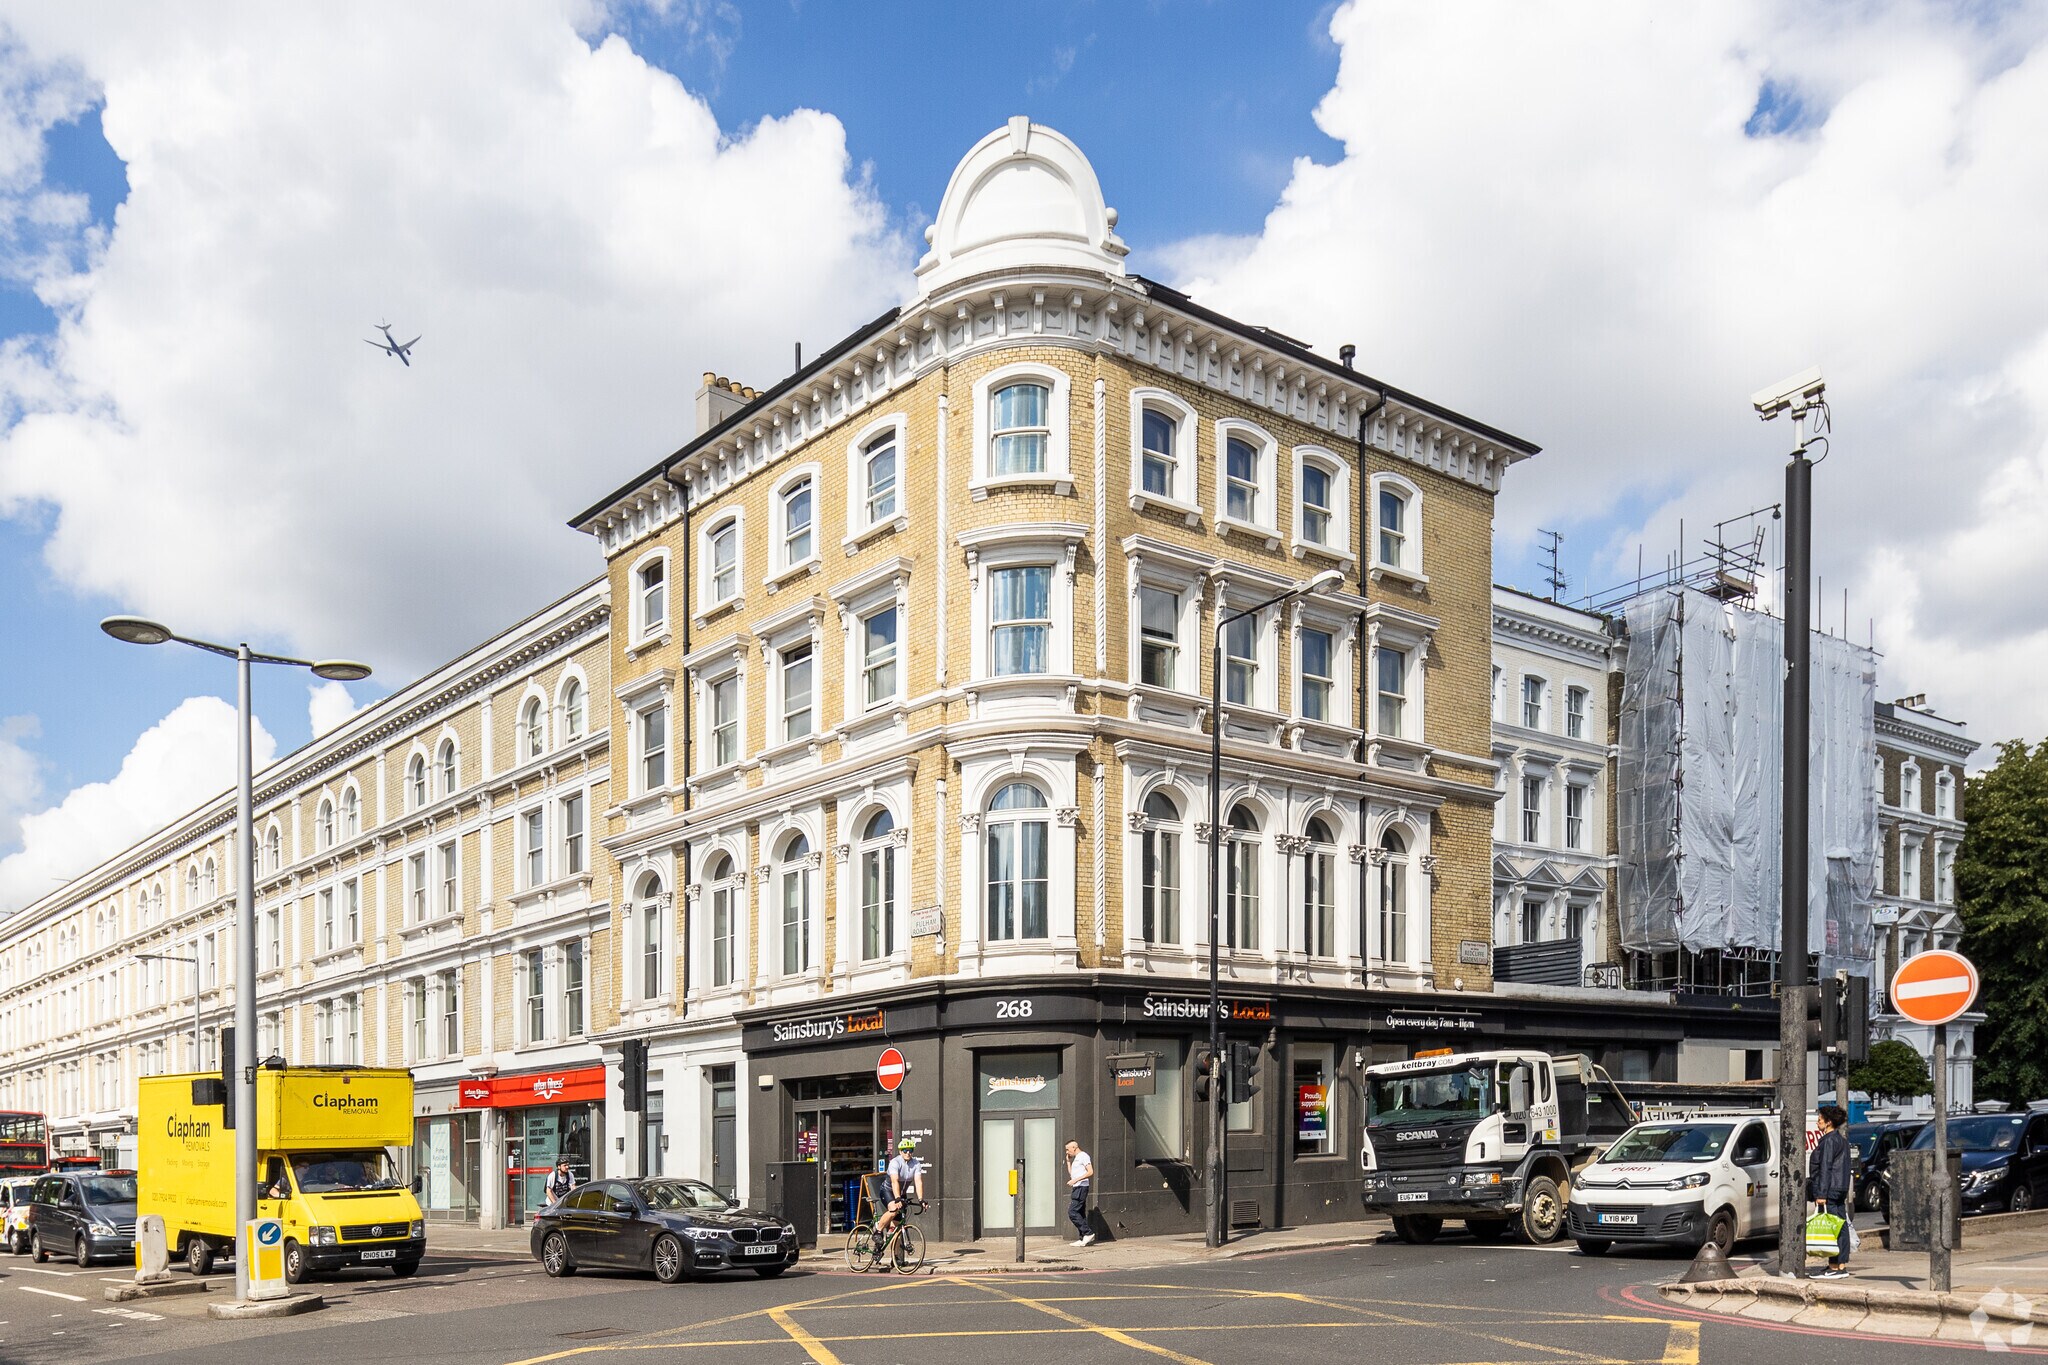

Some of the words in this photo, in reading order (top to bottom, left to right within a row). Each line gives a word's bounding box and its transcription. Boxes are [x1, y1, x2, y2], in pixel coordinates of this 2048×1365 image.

[916, 919, 937, 929] FULHAM
[913, 927, 927, 935] ROAD
[996, 1000, 1032, 1018] 268
[1143, 997, 1229, 1019] Sainsbur's
[1233, 1001, 1271, 1020] Local
[773, 1016, 845, 1041] Sainsbury's
[847, 1010, 884, 1032] Local
[1386, 1015, 1405, 1028] Open
[1406, 1018, 1425, 1029] every
[1426, 1017, 1438, 1029] day
[1439, 1017, 1454, 1028] 7am
[1459, 1018, 1475, 1030] 11pm
[1117, 1068, 1152, 1078] Sainsbury's
[534, 1079, 547, 1091] urban
[988, 1074, 1045, 1087] Sainsbury's
[1117, 1077, 1135, 1087] Local
[313, 1091, 378, 1110] Clapham
[1304, 1093, 1322, 1101] Proudly
[1543, 1105, 1556, 1116] 1000
[167, 1111, 211, 1143] Clapham
[924, 1128, 932, 1136] day
[1396, 1130, 1439, 1141] SCANIA
[186, 1141, 211, 1151] REMOVALS
[1604, 1214, 1620, 1223] LY18
[1621, 1214, 1635, 1222] MPX
[747, 1246, 763, 1254] BT67
[764, 1245, 775, 1253] WFO
